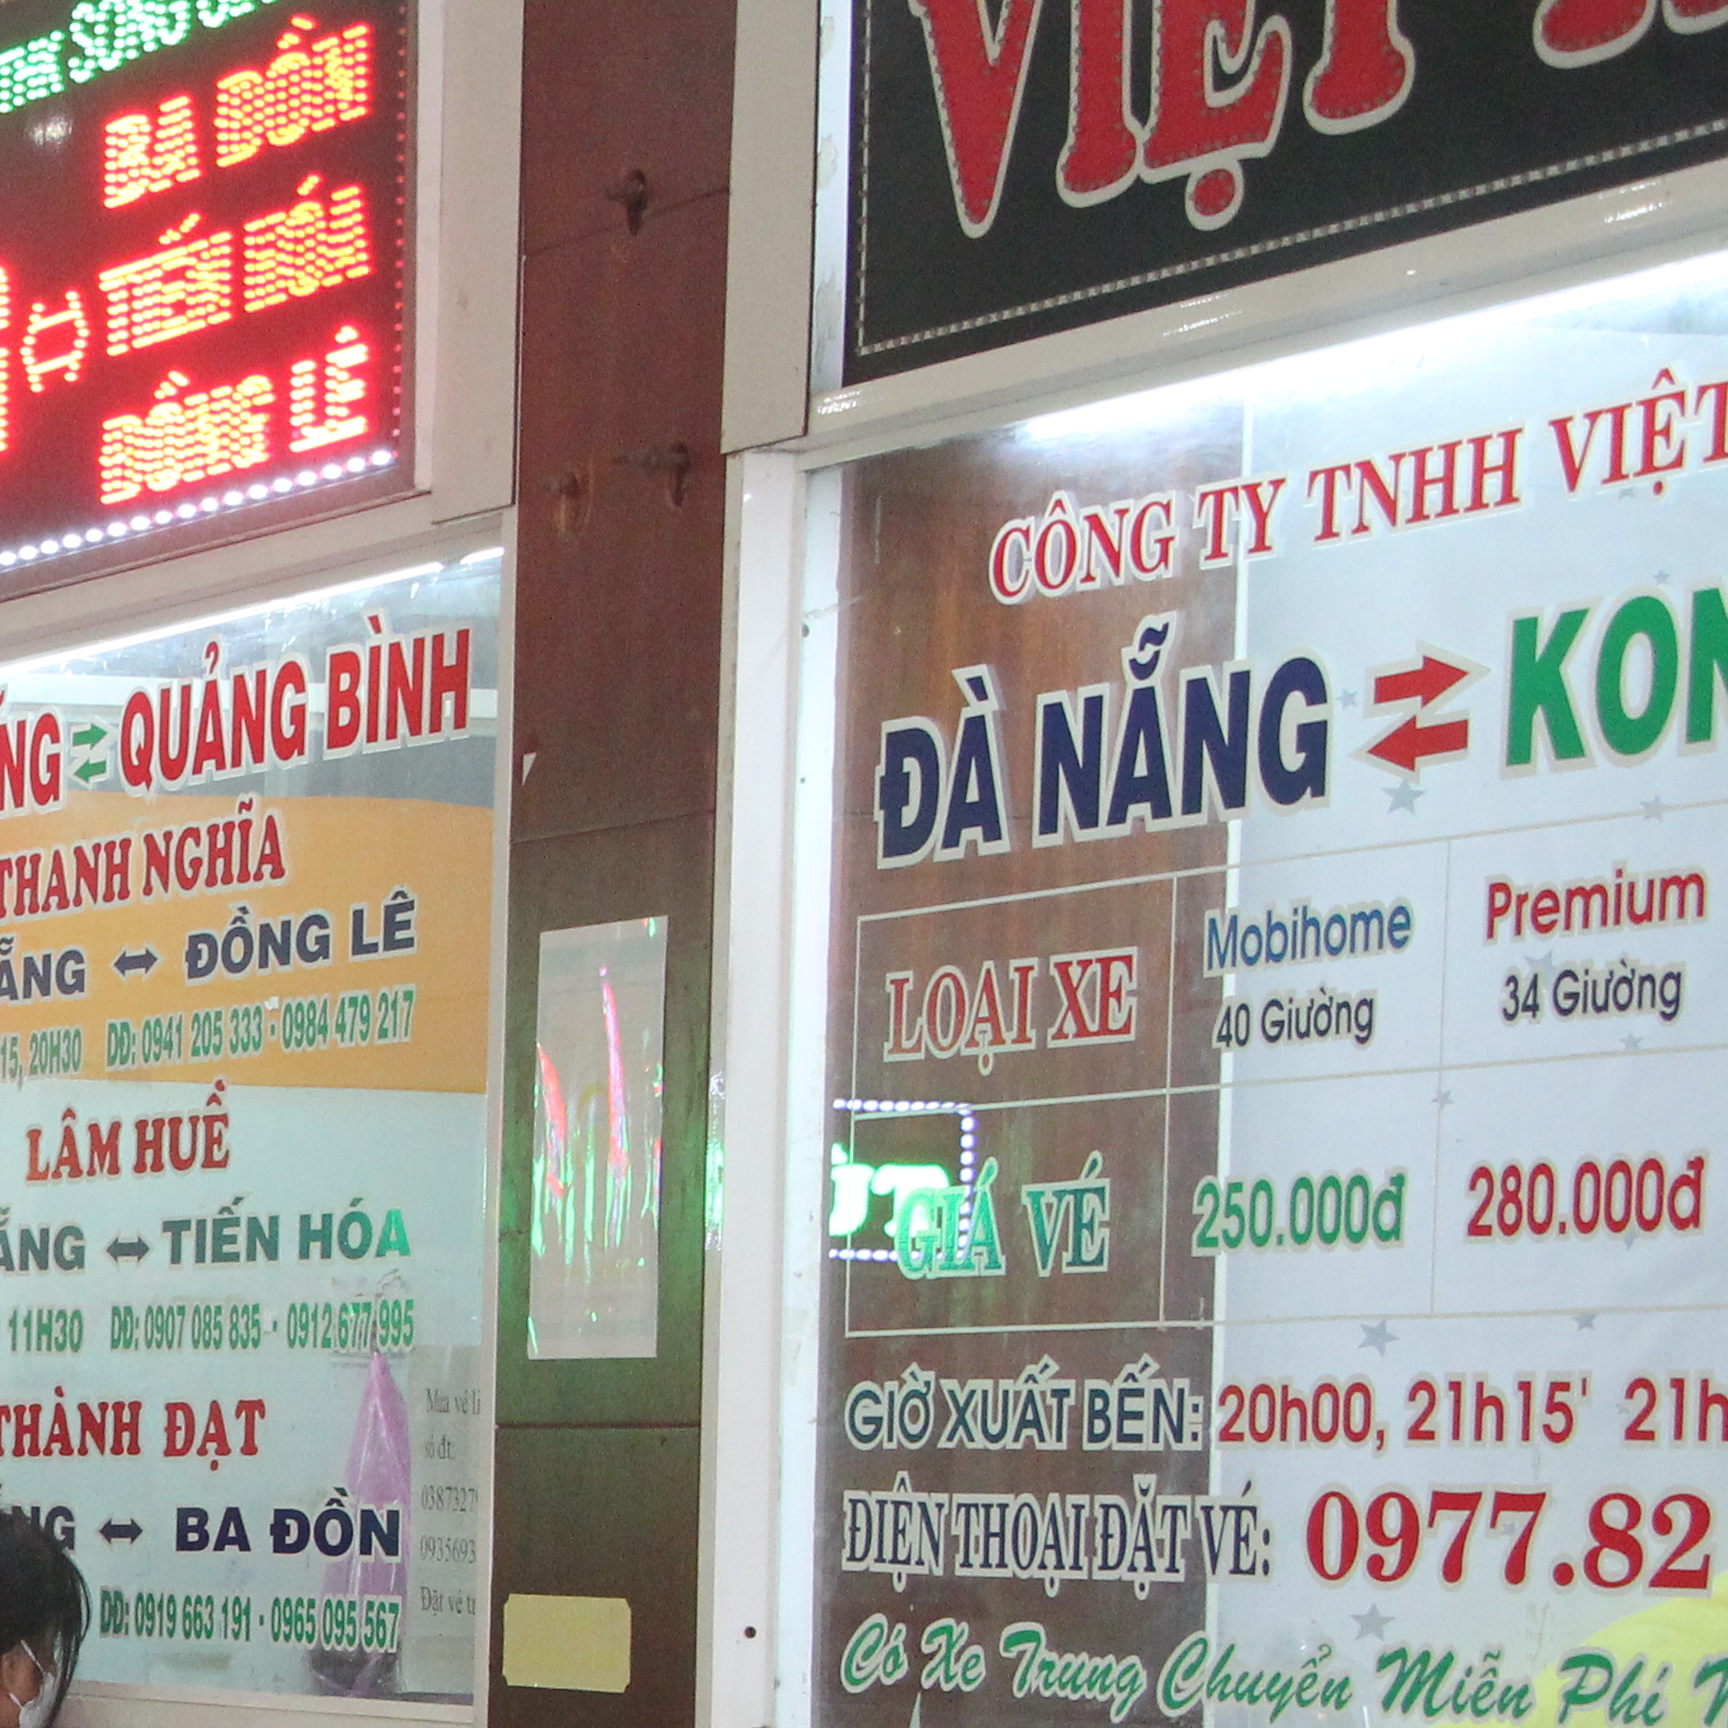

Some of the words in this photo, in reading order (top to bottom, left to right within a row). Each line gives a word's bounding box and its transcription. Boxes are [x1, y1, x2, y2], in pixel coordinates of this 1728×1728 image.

[101, 94, 201, 210] BA
[990, 494, 1175, 604] CÔNG
[1198, 479, 1286, 566] TY
[1308, 427, 1523, 543] TNHH
[119, 640, 307, 791] QUẢNG
[325, 616, 470, 751] BÌNH
[879, 666, 1004, 863] ĐÀ
[1037, 618, 1331, 838] NẴNG
[144, 798, 285, 896] NGHĨA
[184, 905, 330, 980] ĐỒNG
[350, 884, 417, 956] LÊ
[884, 960, 1037, 1073] LOẠI
[1050, 948, 1136, 1049] XE
[1205, 902, 1412, 972] Mobihome
[1486, 869, 1706, 942] Premium
[28, 1028, 82, 1075] 20H30
[141, 1014, 183, 1067] 0941
[190, 1010, 223, 1058] 205
[228, 1005, 263, 1055] 333
[281, 1002, 329, 1051] 0984
[334, 998, 372, 1045] 479
[378, 992, 414, 1040] 217
[1214, 1003, 1252, 1050] 40
[1260, 990, 1376, 1047] Giường
[1502, 974, 1540, 1021] 34
[1552, 966, 1683, 1023] Giường
[26, 1107, 119, 1181] LÂM
[162, 1196, 280, 1265] TIẾN
[298, 1198, 410, 1260] HÓA
[897, 1158, 1004, 1280] GIÁ
[1023, 1151, 1109, 1275] VÉ
[1195, 1171, 1407, 1255] 250.000đ
[1468, 1157, 1706, 1240] 280.000đ
[9, 1309, 82, 1353] 11H30
[144, 1305, 184, 1349] 0907
[190, 1304, 223, 1349] 085
[227, 1303, 261, 1348] 835
[285, 1303, 331, 1349] 0912
[378, 1299, 414, 1348] 995
[163, 1400, 265, 1470] ĐẠT
[847, 1366, 937, 1451] GIỜ
[944, 1357, 1076, 1451] XUẤT
[1087, 1356, 1203, 1451] BẾN:
[1218, 1381, 1387, 1451] 20h00,
[1409, 1378, 1588, 1445] 21h15'
[175, 1507, 251, 1553] BA
[269, 1488, 400, 1557] ĐỒN
[421, 1486, 479, 1512] 0387327
[844, 1472, 948, 1592] ĐIỆN
[955, 1494, 1089, 1596] THOẠI
[1098, 1476, 1189, 1597] ĐẶT
[1197, 1481, 1273, 1578] VÉ:
[1305, 1490, 1713, 1589] 0977.82
[134, 1591, 177, 1638] 0919
[182, 1594, 215, 1640] 663
[222, 1596, 252, 1641] 191
[271, 1597, 315, 1645] 0965
[323, 1598, 356, 1648] 095
[362, 1600, 399, 1651] 567
[842, 1614, 907, 1693] Có
[921, 1616, 986, 1690] Xe
[1000, 1622, 1145, 1720] Trung
[1157, 1630, 1352, 1718] Chuyển
[1376, 1649, 1533, 1722] Miễn
[1557, 1649, 1668, 1727] Phí
